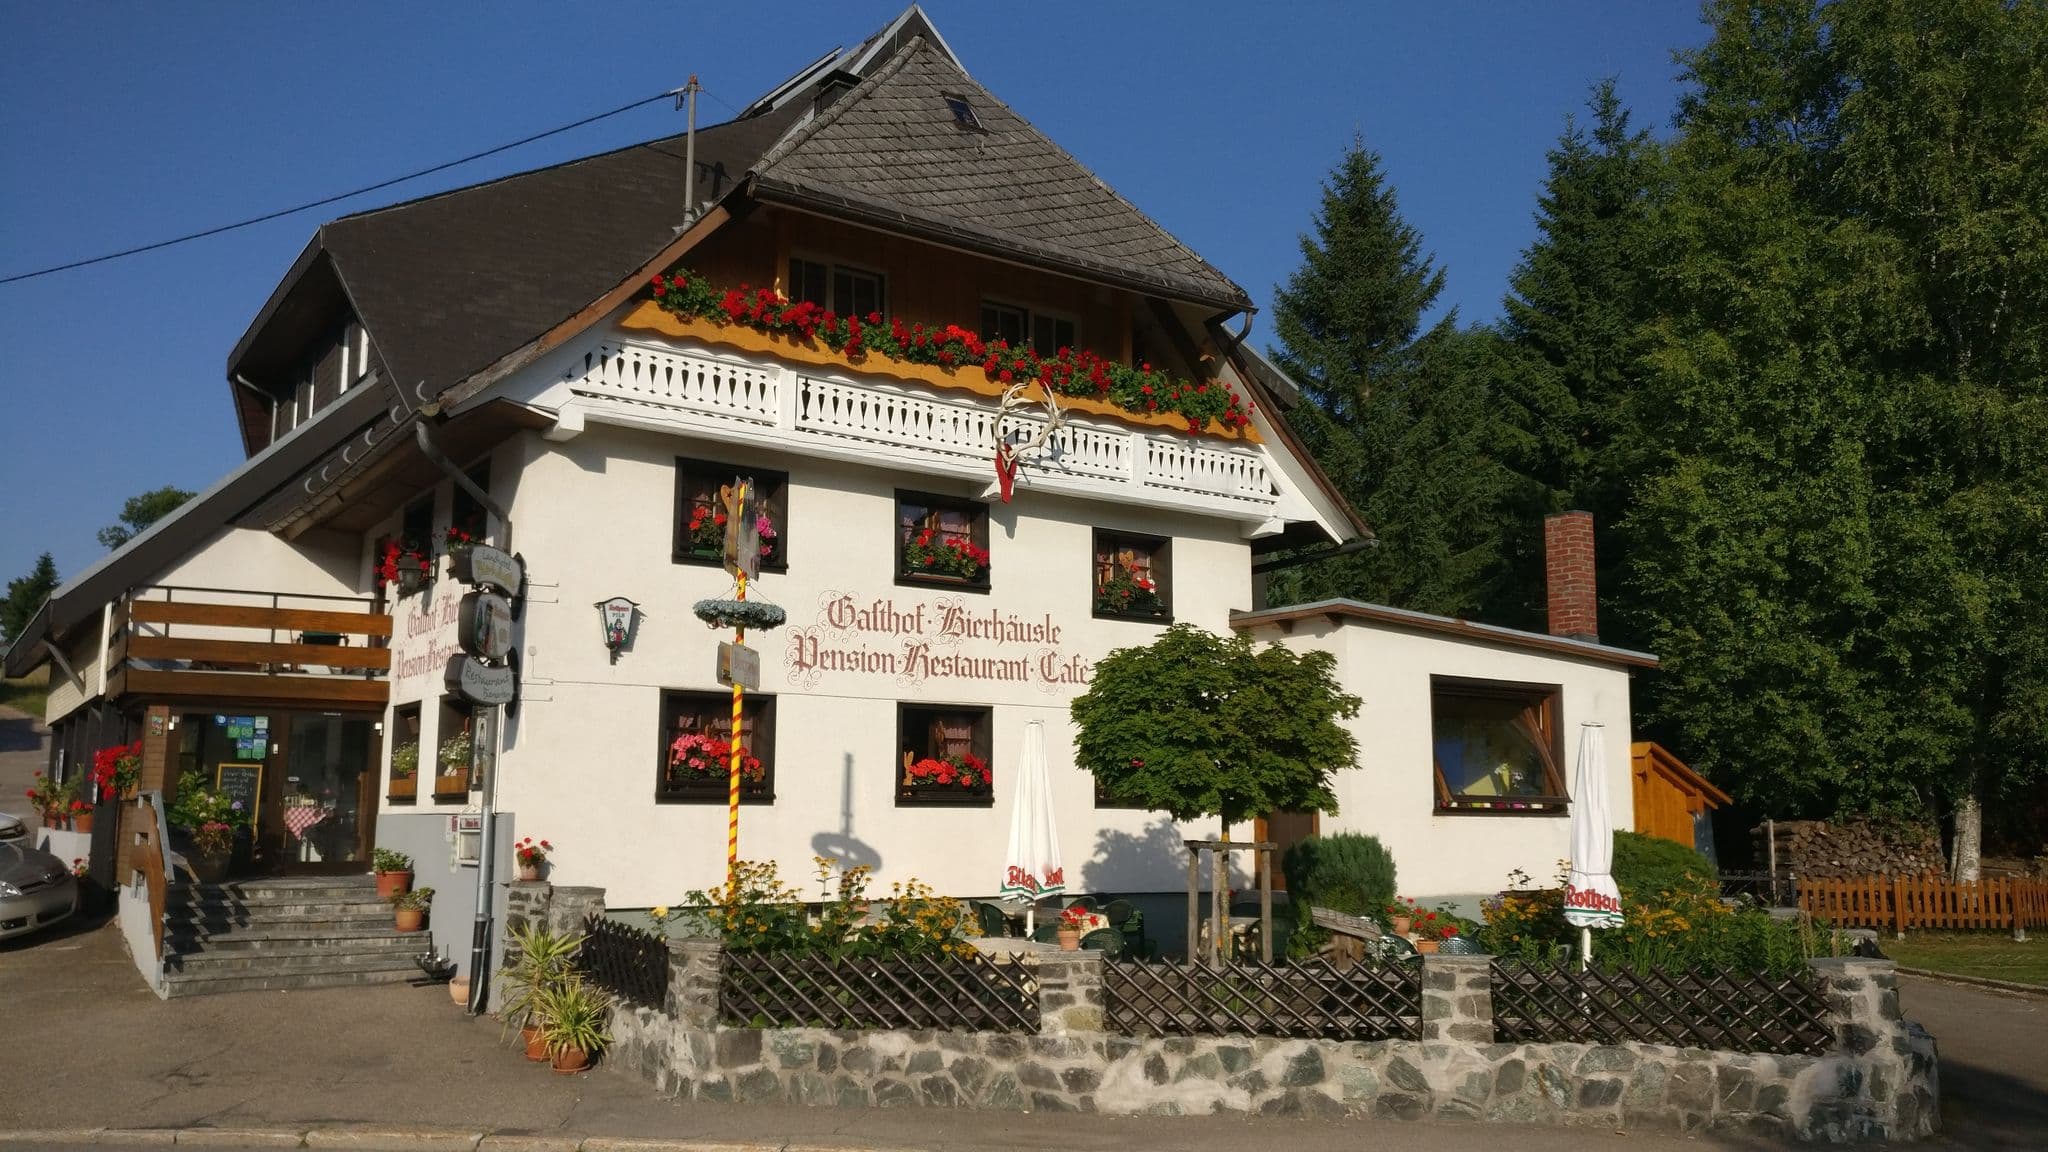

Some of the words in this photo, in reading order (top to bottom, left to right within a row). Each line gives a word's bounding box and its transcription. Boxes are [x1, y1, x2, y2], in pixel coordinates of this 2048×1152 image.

[935, 602, 1062, 646] Bierhäusle
[790, 632, 896, 678] Pension
[900, 642, 1030, 684] Restaurant
[1039, 650, 1089, 685] Café
[1564, 884, 1622, 913] Rothau
